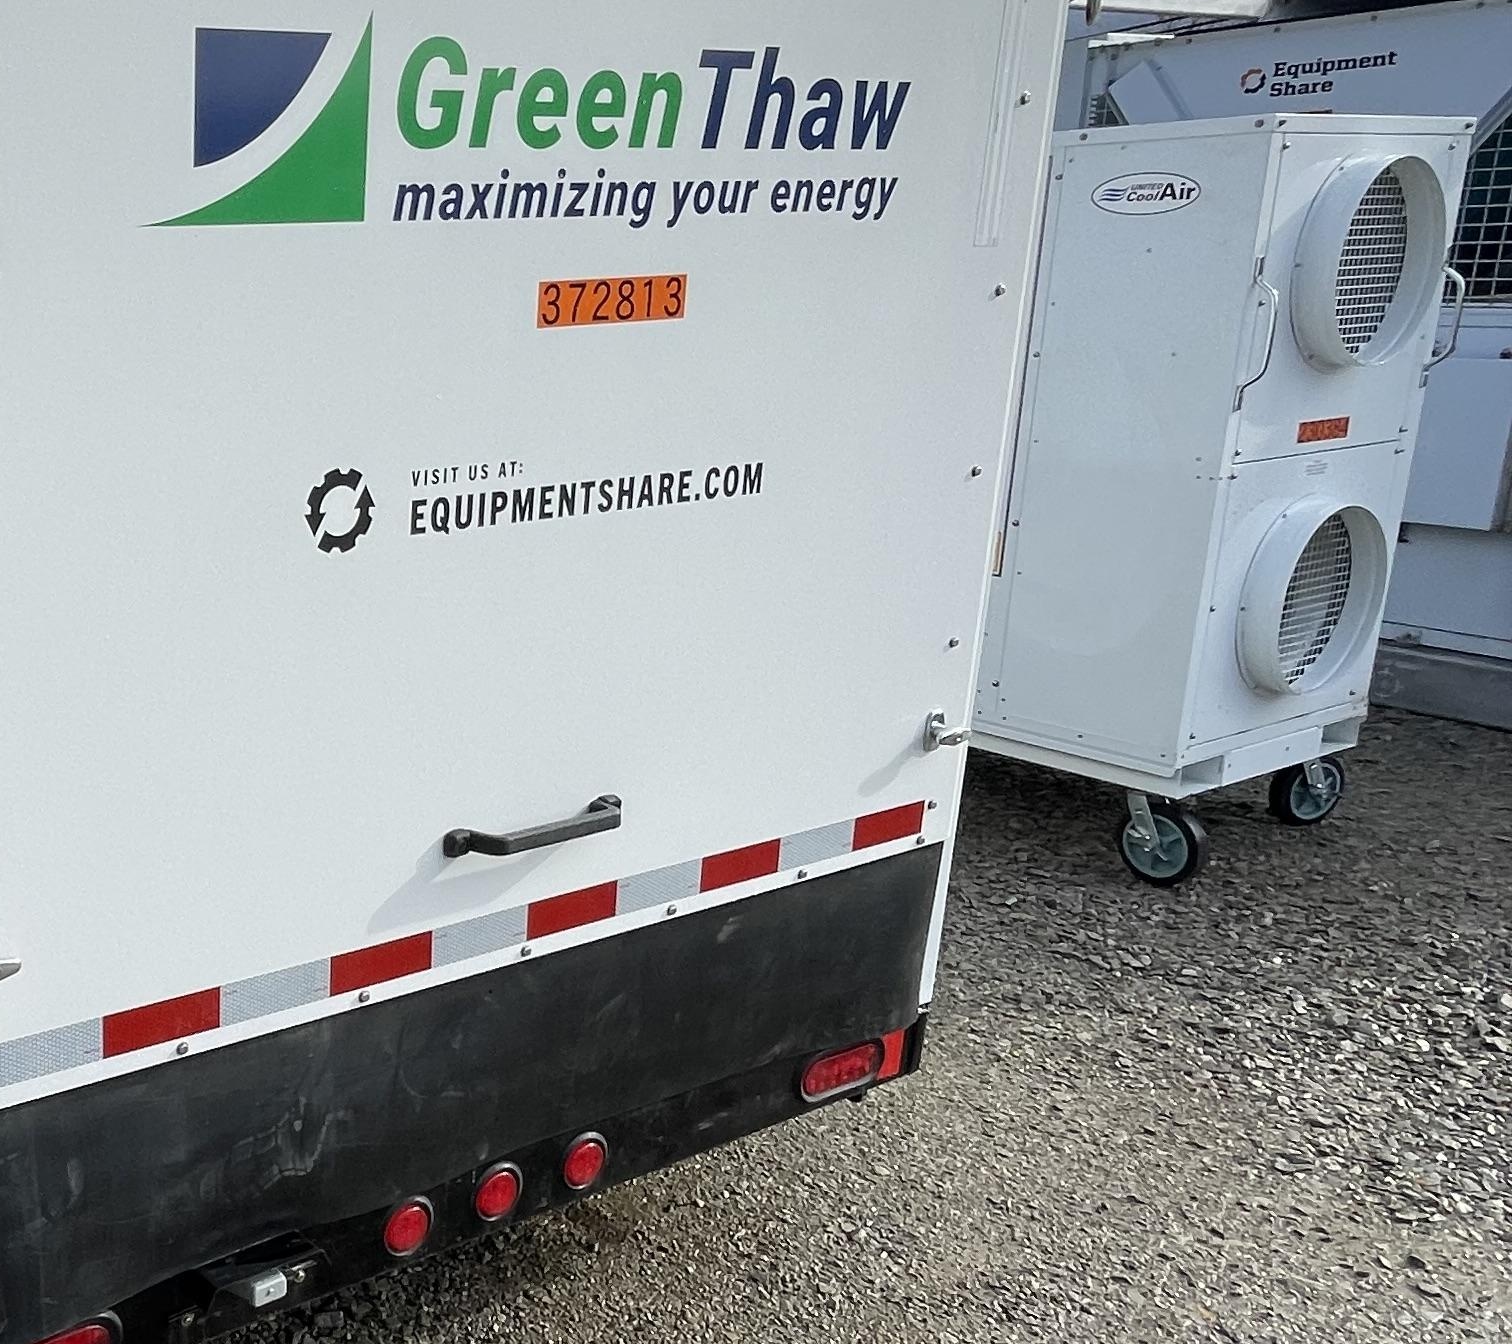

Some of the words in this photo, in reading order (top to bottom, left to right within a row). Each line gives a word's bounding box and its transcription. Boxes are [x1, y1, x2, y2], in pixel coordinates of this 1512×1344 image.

[1272, 51, 1399, 80] Equipment
[1269, 78, 1334, 98] Share
[392, 167, 657, 229] maximizing
[666, 176, 759, 229] your
[769, 175, 899, 222] energy
[541, 275, 683, 326] 372813
[411, 466, 459, 487] VISIT
[468, 463, 489, 481] US
[497, 460, 525, 477] AT:
[409, 461, 764, 536] EQUIPMENTSHARE.COM
